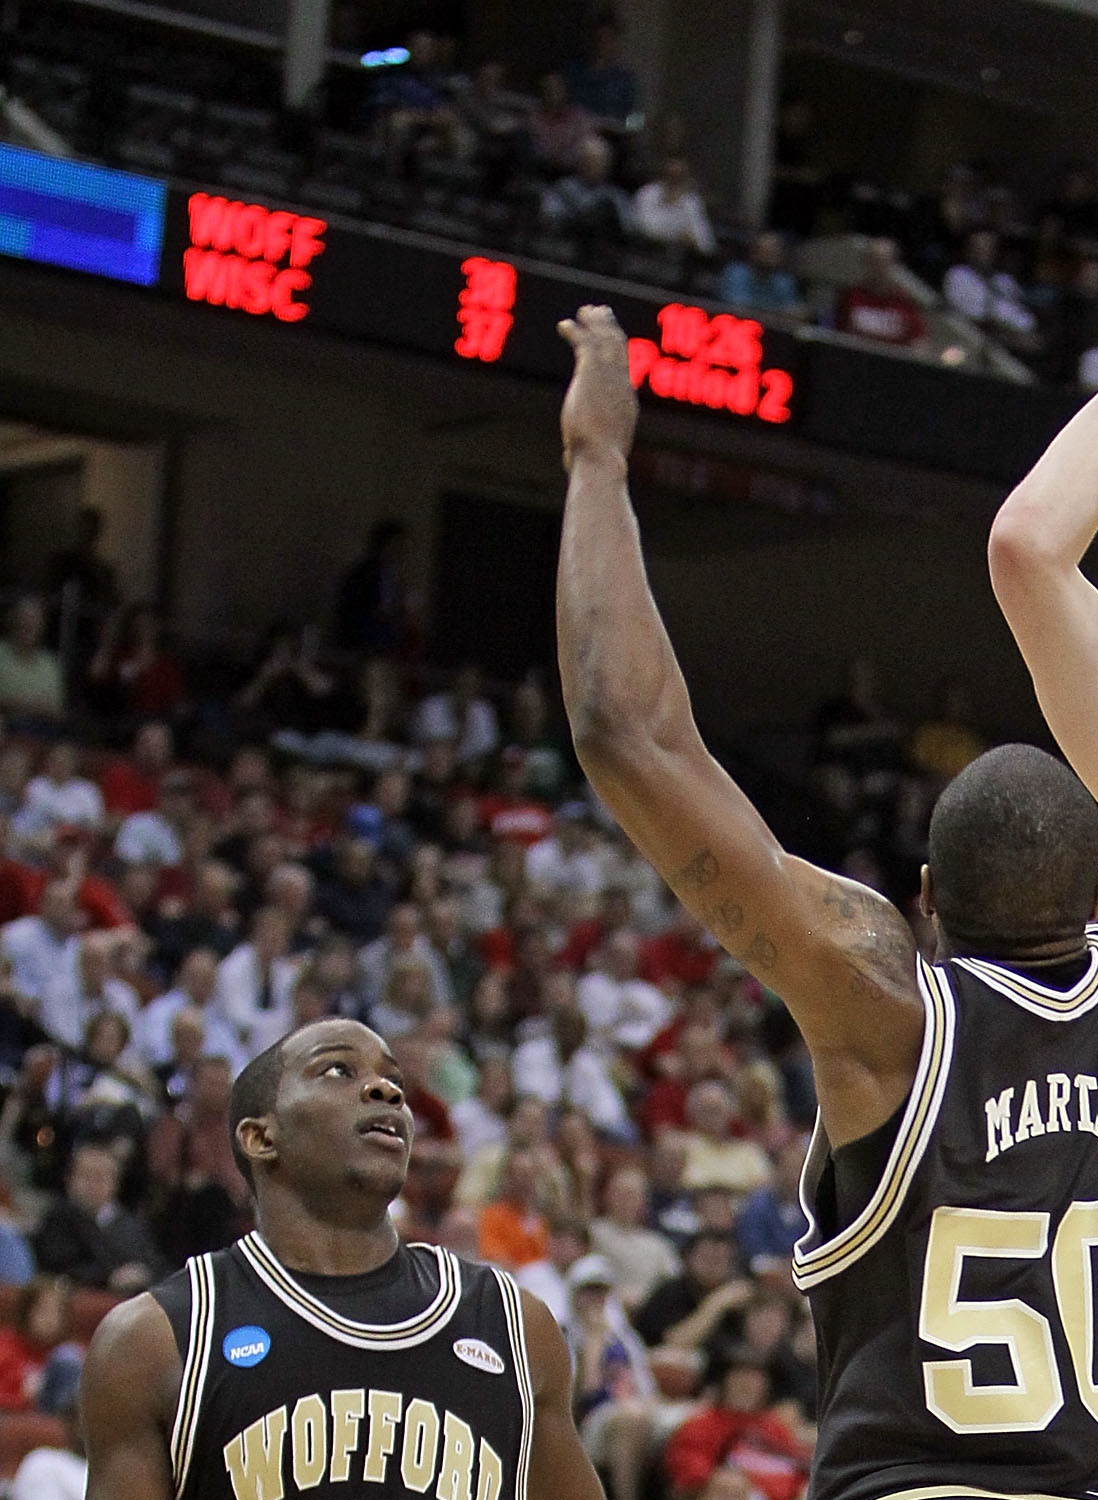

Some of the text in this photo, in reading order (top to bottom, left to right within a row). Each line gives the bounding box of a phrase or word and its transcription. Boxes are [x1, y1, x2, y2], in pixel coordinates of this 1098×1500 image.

[188, 192, 327, 268] WOFF
[183, 246, 312, 323] WISC
[757, 368, 793, 424] 2
[230, 1342, 265, 1361] NCAA
